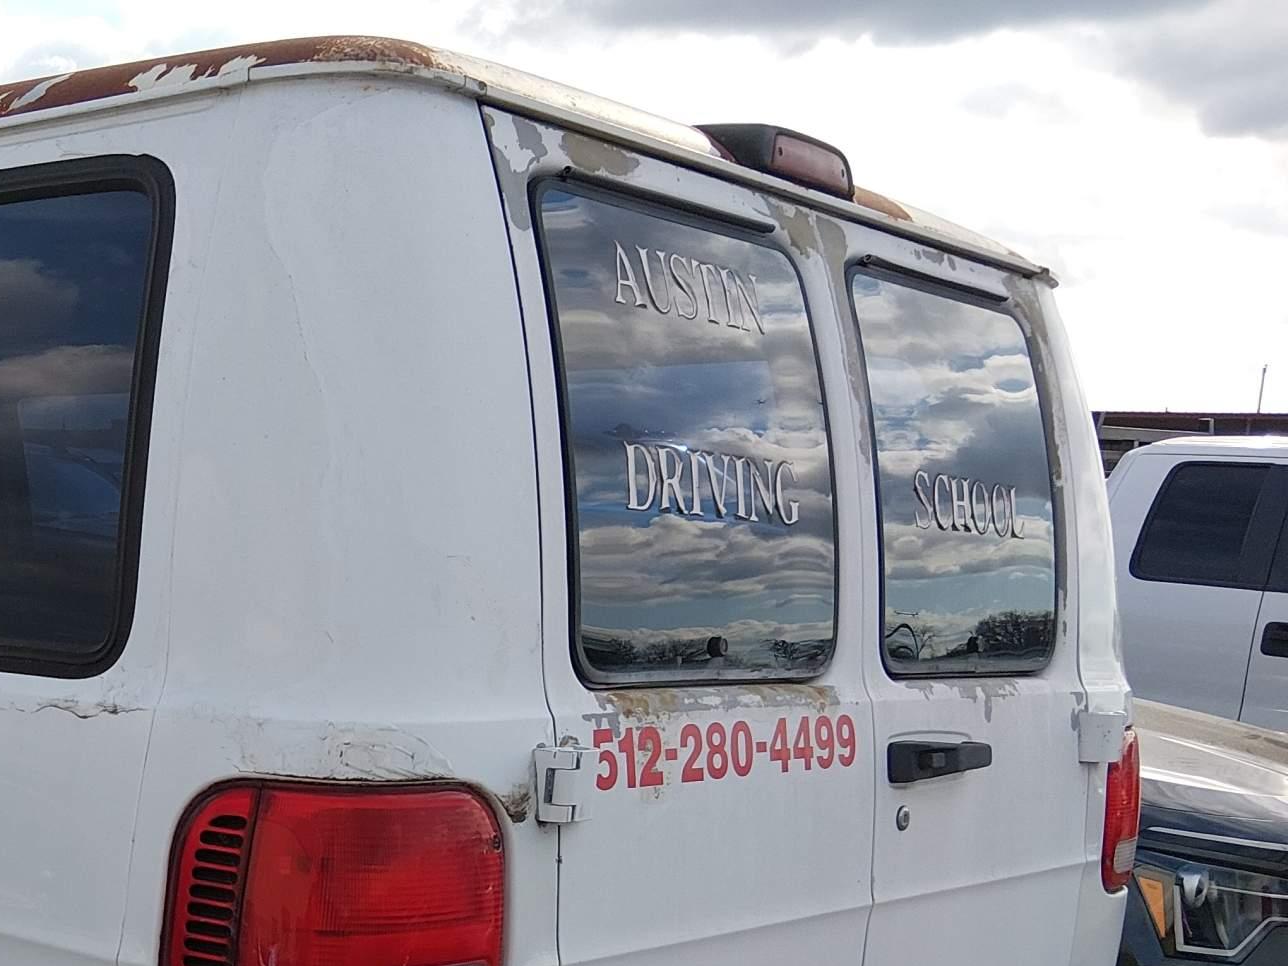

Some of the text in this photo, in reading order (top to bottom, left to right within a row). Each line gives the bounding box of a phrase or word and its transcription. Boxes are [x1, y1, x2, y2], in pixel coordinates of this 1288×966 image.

[614, 240, 765, 335] AUSTIN
[623, 440, 1025, 539] DRIVING SCHOOL
[592, 714, 856, 791] 512-280-4499
